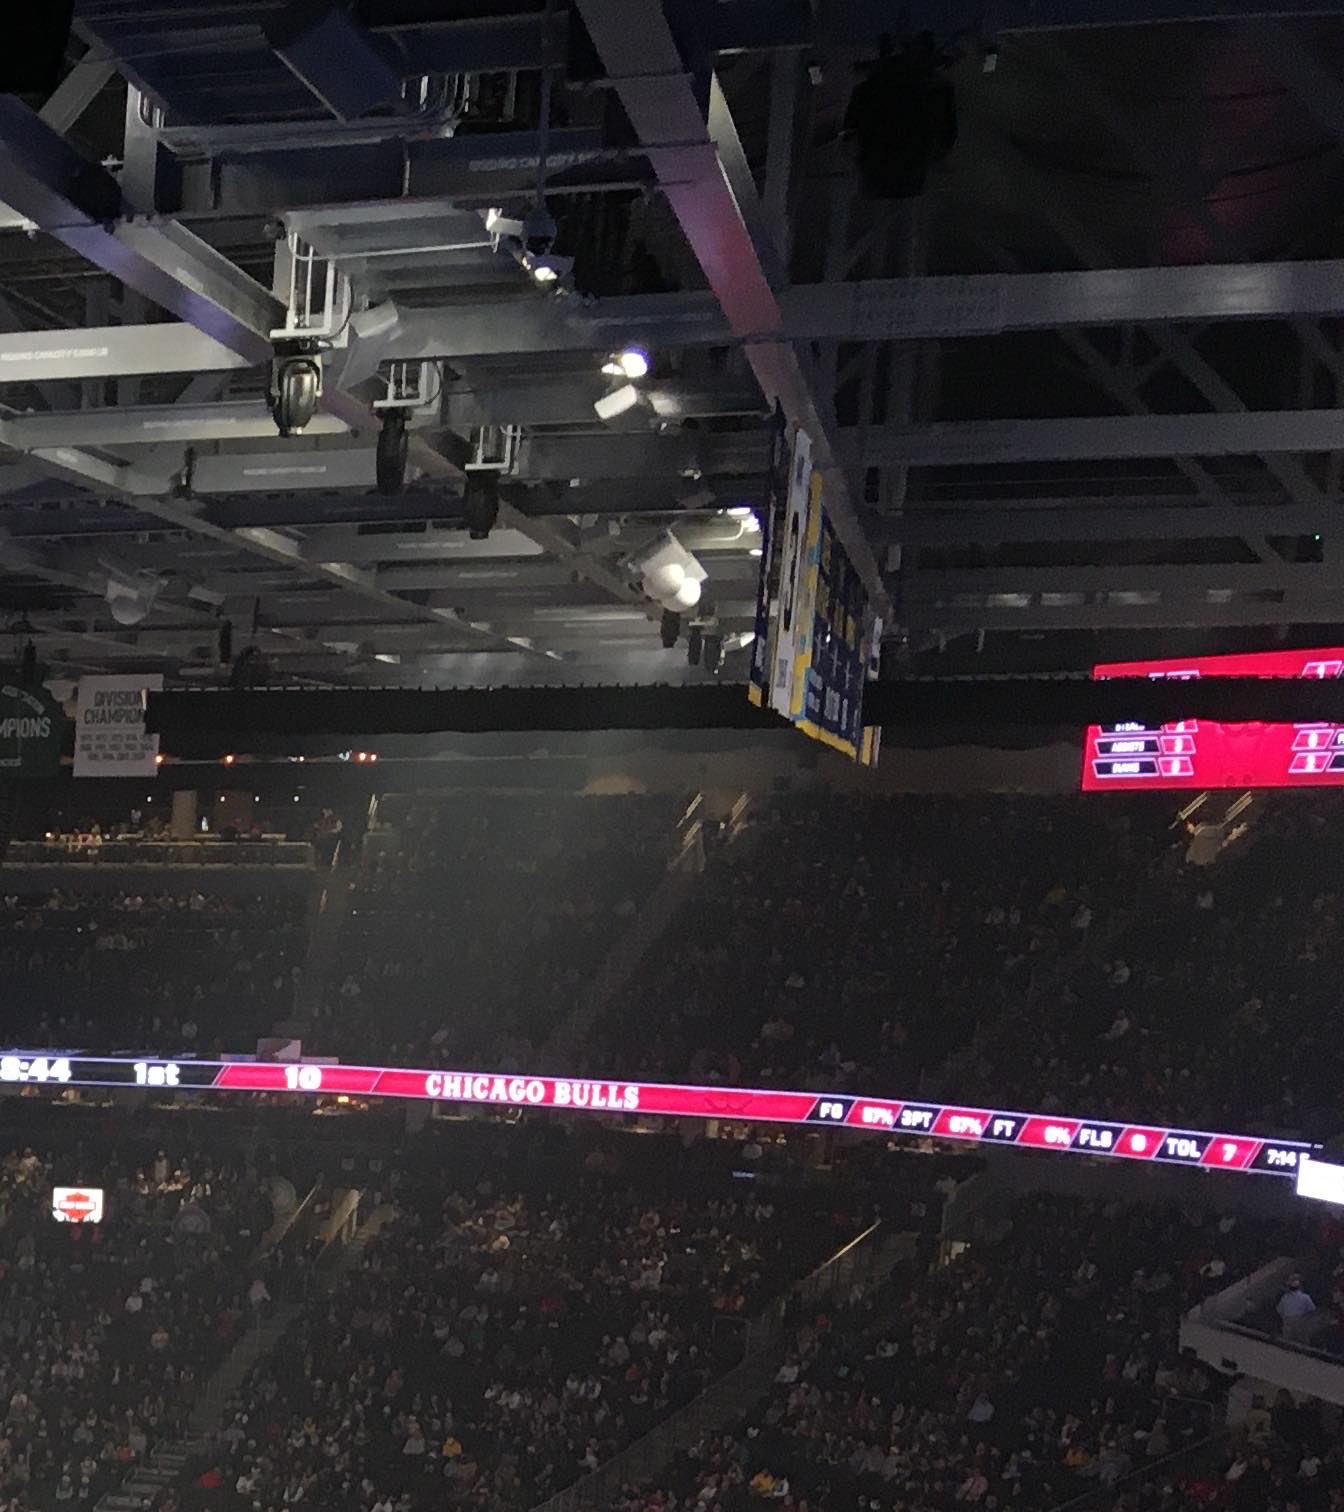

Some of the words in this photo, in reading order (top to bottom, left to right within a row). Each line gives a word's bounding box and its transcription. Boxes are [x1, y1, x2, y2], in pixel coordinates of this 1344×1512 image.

[0, 1057, 72, 1083] 8:44
[134, 1063, 179, 1086] 1st
[285, 1066, 322, 1089] 10
[425, 1073, 545, 1103] CHICAGO
[553, 1081, 640, 1110] BULLS
[901, 1110, 933, 1129] 3PT
[993, 1120, 1015, 1138] FT
[1166, 1138, 1200, 1158] TOL
[1223, 1144, 1235, 1161] 7
[1266, 1148, 1296, 1167] 7:14
